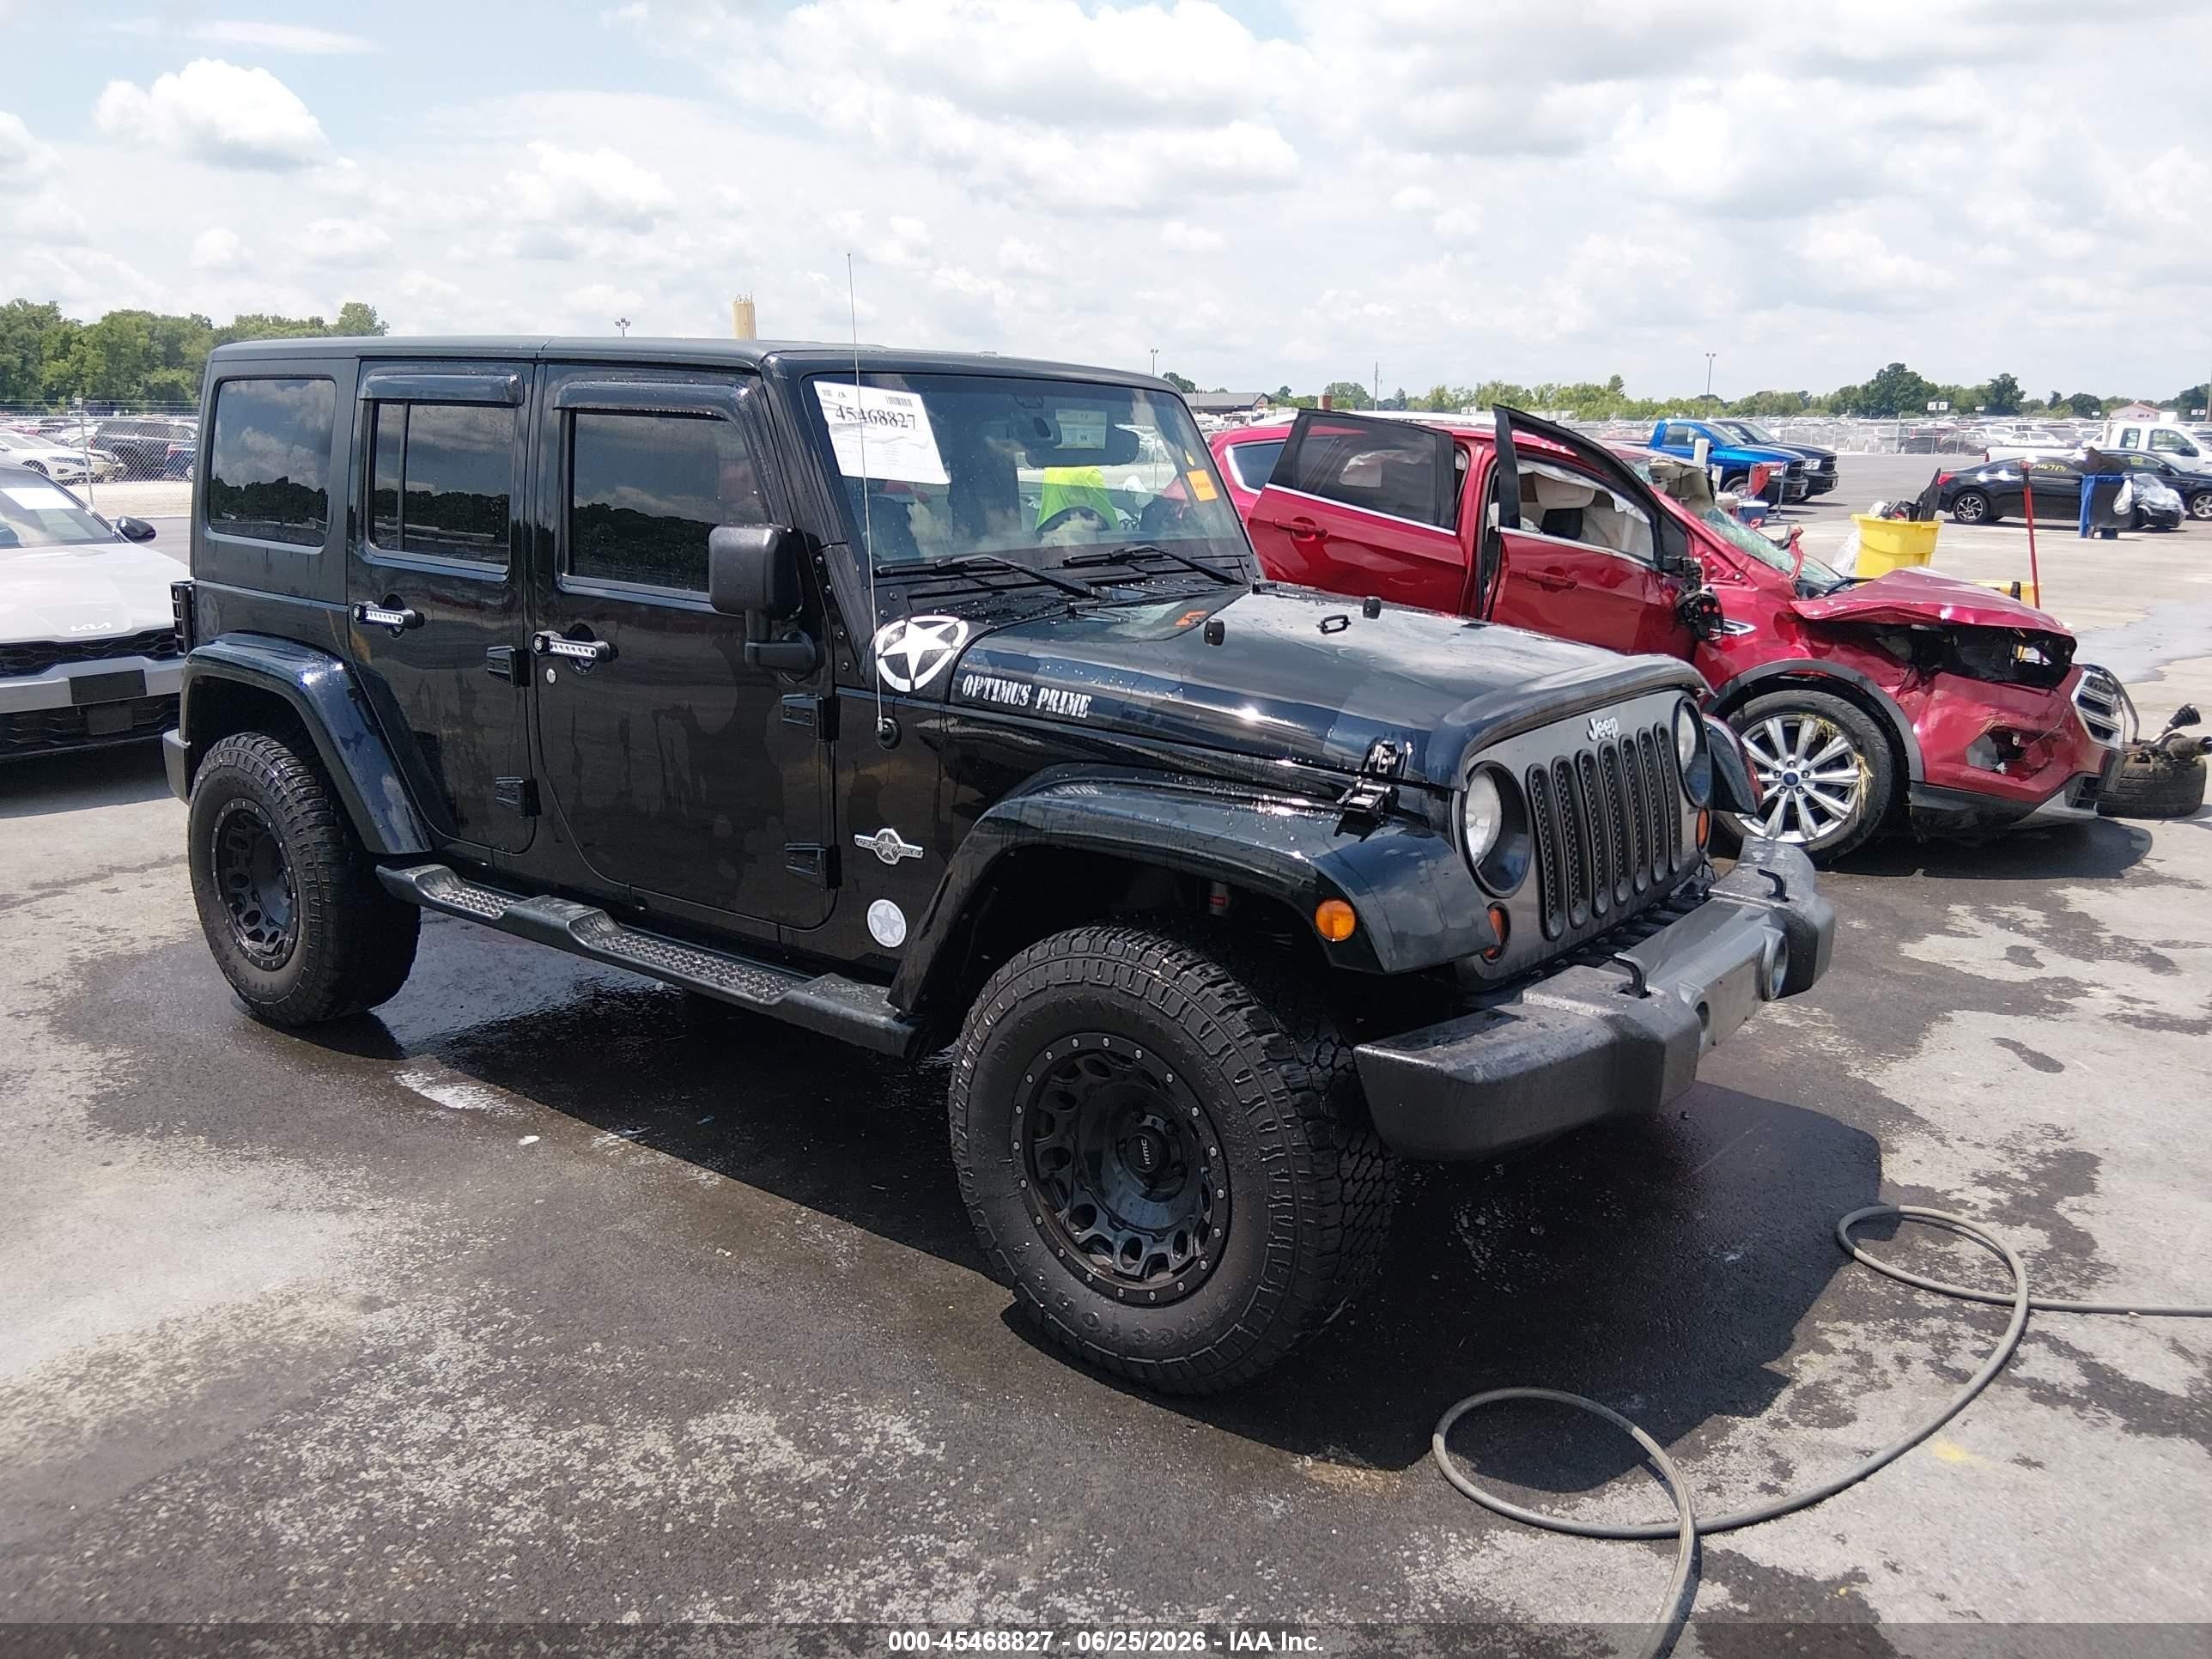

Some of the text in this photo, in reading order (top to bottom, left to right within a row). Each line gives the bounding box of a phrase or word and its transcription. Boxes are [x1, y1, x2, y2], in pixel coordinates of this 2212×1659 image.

[836, 404, 915, 430] 45468827
[962, 674, 1092, 719] OPTIMUS PRIME
[1587, 716, 1619, 741] Jeep
